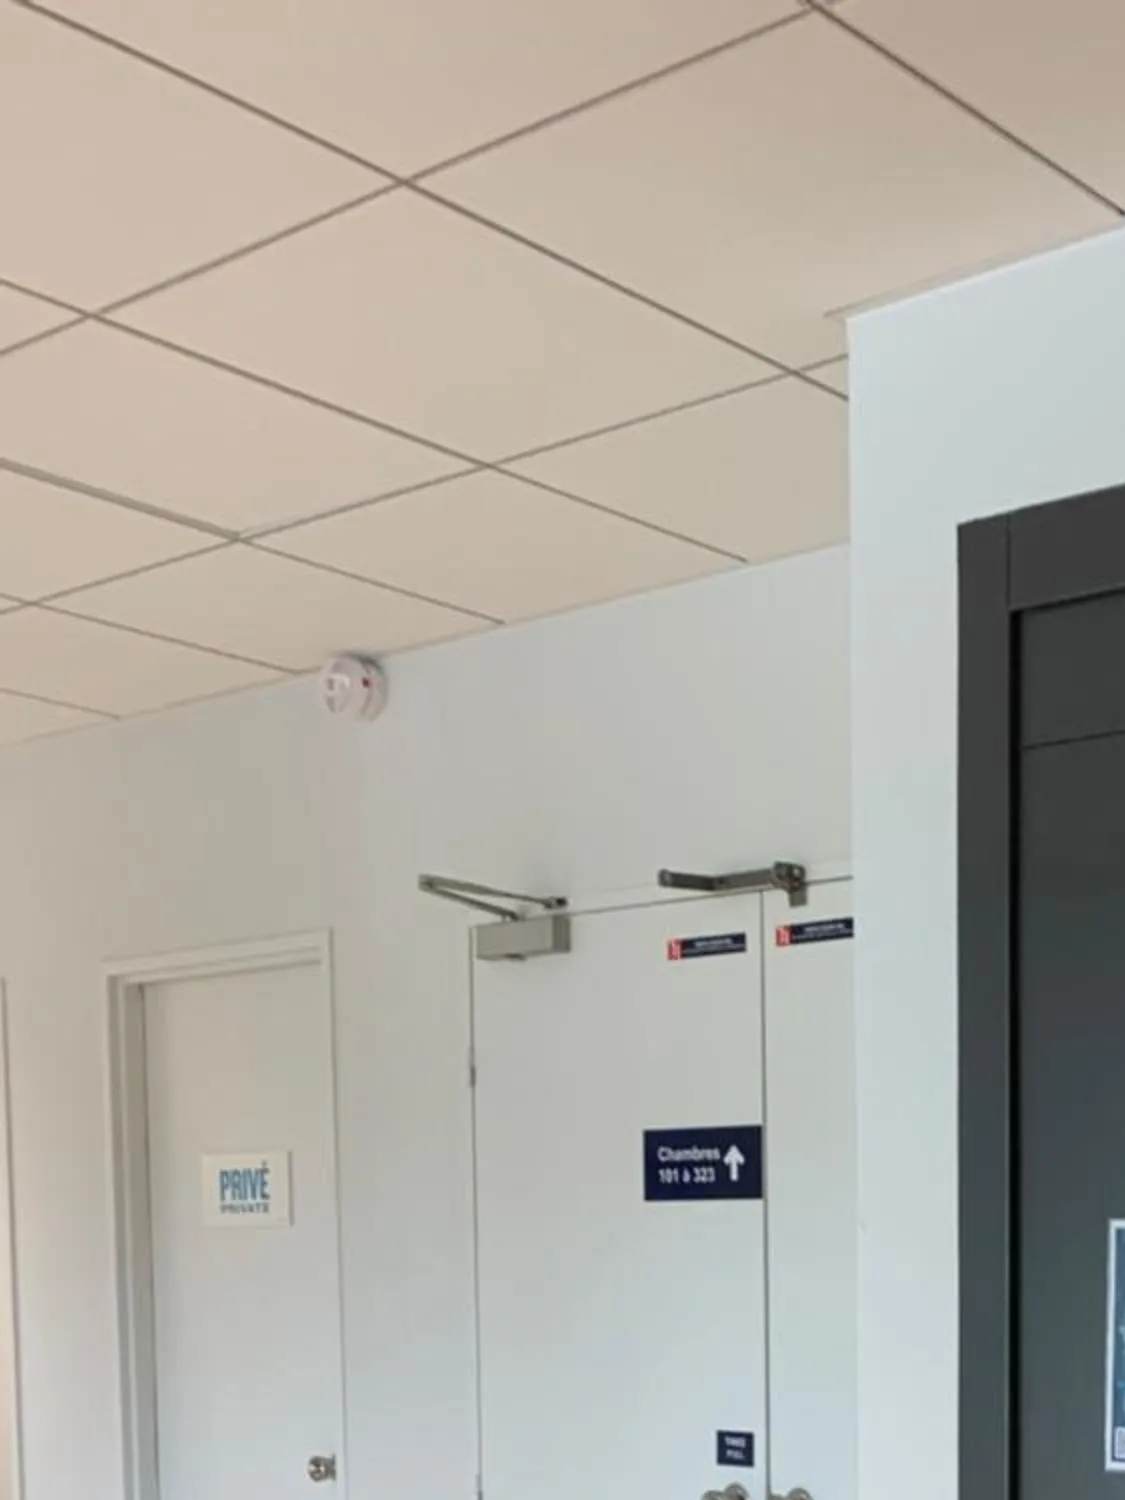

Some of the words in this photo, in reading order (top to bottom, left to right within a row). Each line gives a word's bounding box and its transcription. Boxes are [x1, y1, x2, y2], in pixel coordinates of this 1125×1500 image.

[657, 1145, 721, 1162] Chambres
[219, 1160, 270, 1201] PRIVÉ
[658, 1167, 679, 1184] 101
[693, 1166, 717, 1183] 323
